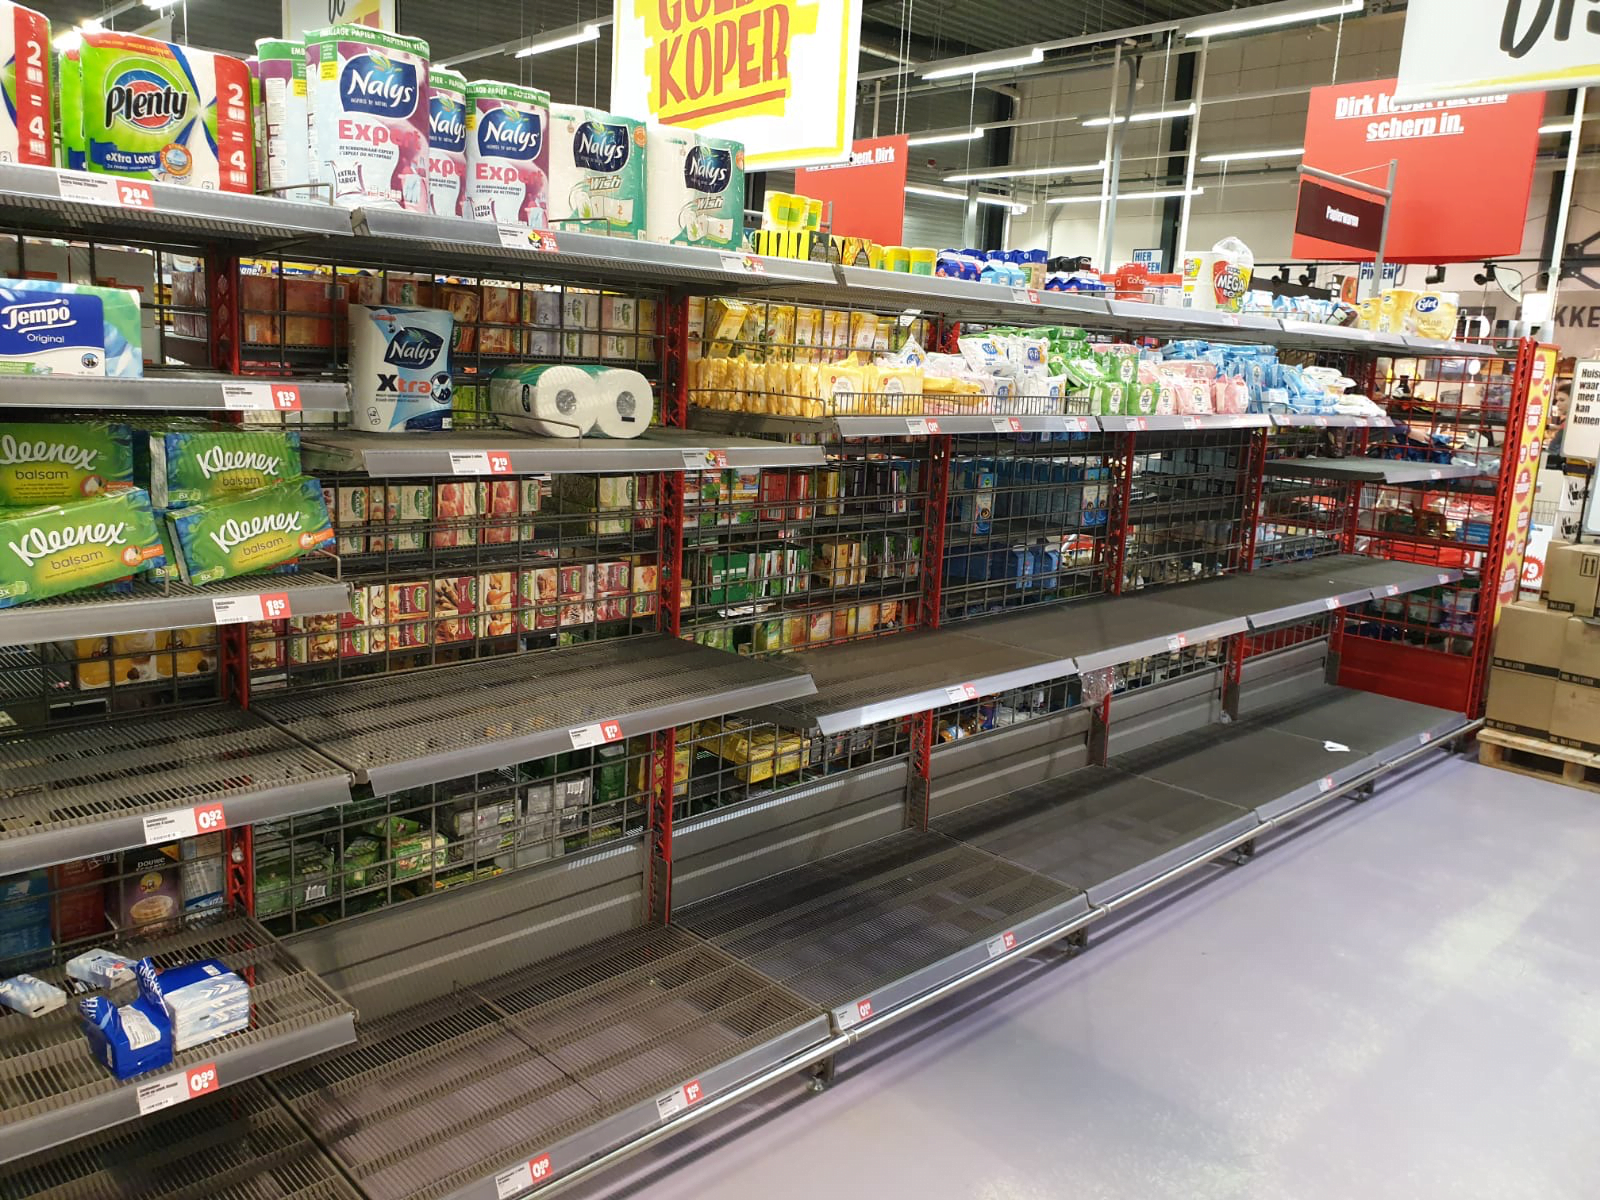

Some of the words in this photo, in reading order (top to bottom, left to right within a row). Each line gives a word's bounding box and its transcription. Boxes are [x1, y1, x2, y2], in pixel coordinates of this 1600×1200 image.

[27, 40, 42, 67] 2
[659, 4, 790, 110] KOPER
[228, 84, 244, 107] 2
[347, 69, 414, 108] Nalys
[105, 82, 188, 129] Plenty
[1336, 94, 1376, 118] Dirk
[29, 115, 44, 139] 4
[484, 120, 539, 152] Nalys
[1367, 115, 1437, 140] scherp
[1439, 112, 1465, 133] in.
[106, 152, 132, 164] eXtra
[134, 154, 156, 166] Long
[578, 133, 624, 164] Nalys
[876, 147, 895, 162] Dirk
[230, 150, 246, 170] 4
[589, 175, 622, 190] Wish
[690, 160, 727, 186] Nalys
[1135, 252, 1152, 262] HIER
[1217, 274, 1244, 292] MEGA
[1360, 268, 1394, 280] PINEN
[1, 299, 71, 330] Tempo
[26, 334, 64, 344] Original
[389, 340, 439, 366] Nalys
[376, 374, 432, 394] Xtra
[1579, 381, 1600, 390] waar
[1575, 403, 1590, 413] kan
[1577, 393, 1595, 402] mee
[1573, 415, 1600, 425] komen
[0, 434, 98, 471] leenex
[196, 445, 280, 480] Kleenex
[15, 470, 69, 480] balsam
[222, 474, 260, 488] balsam
[210, 510, 303, 554] Kleenex
[8, 522, 128, 568] Kleenex
[242, 536, 284, 557] balsam
[51, 549, 104, 570] balsam
